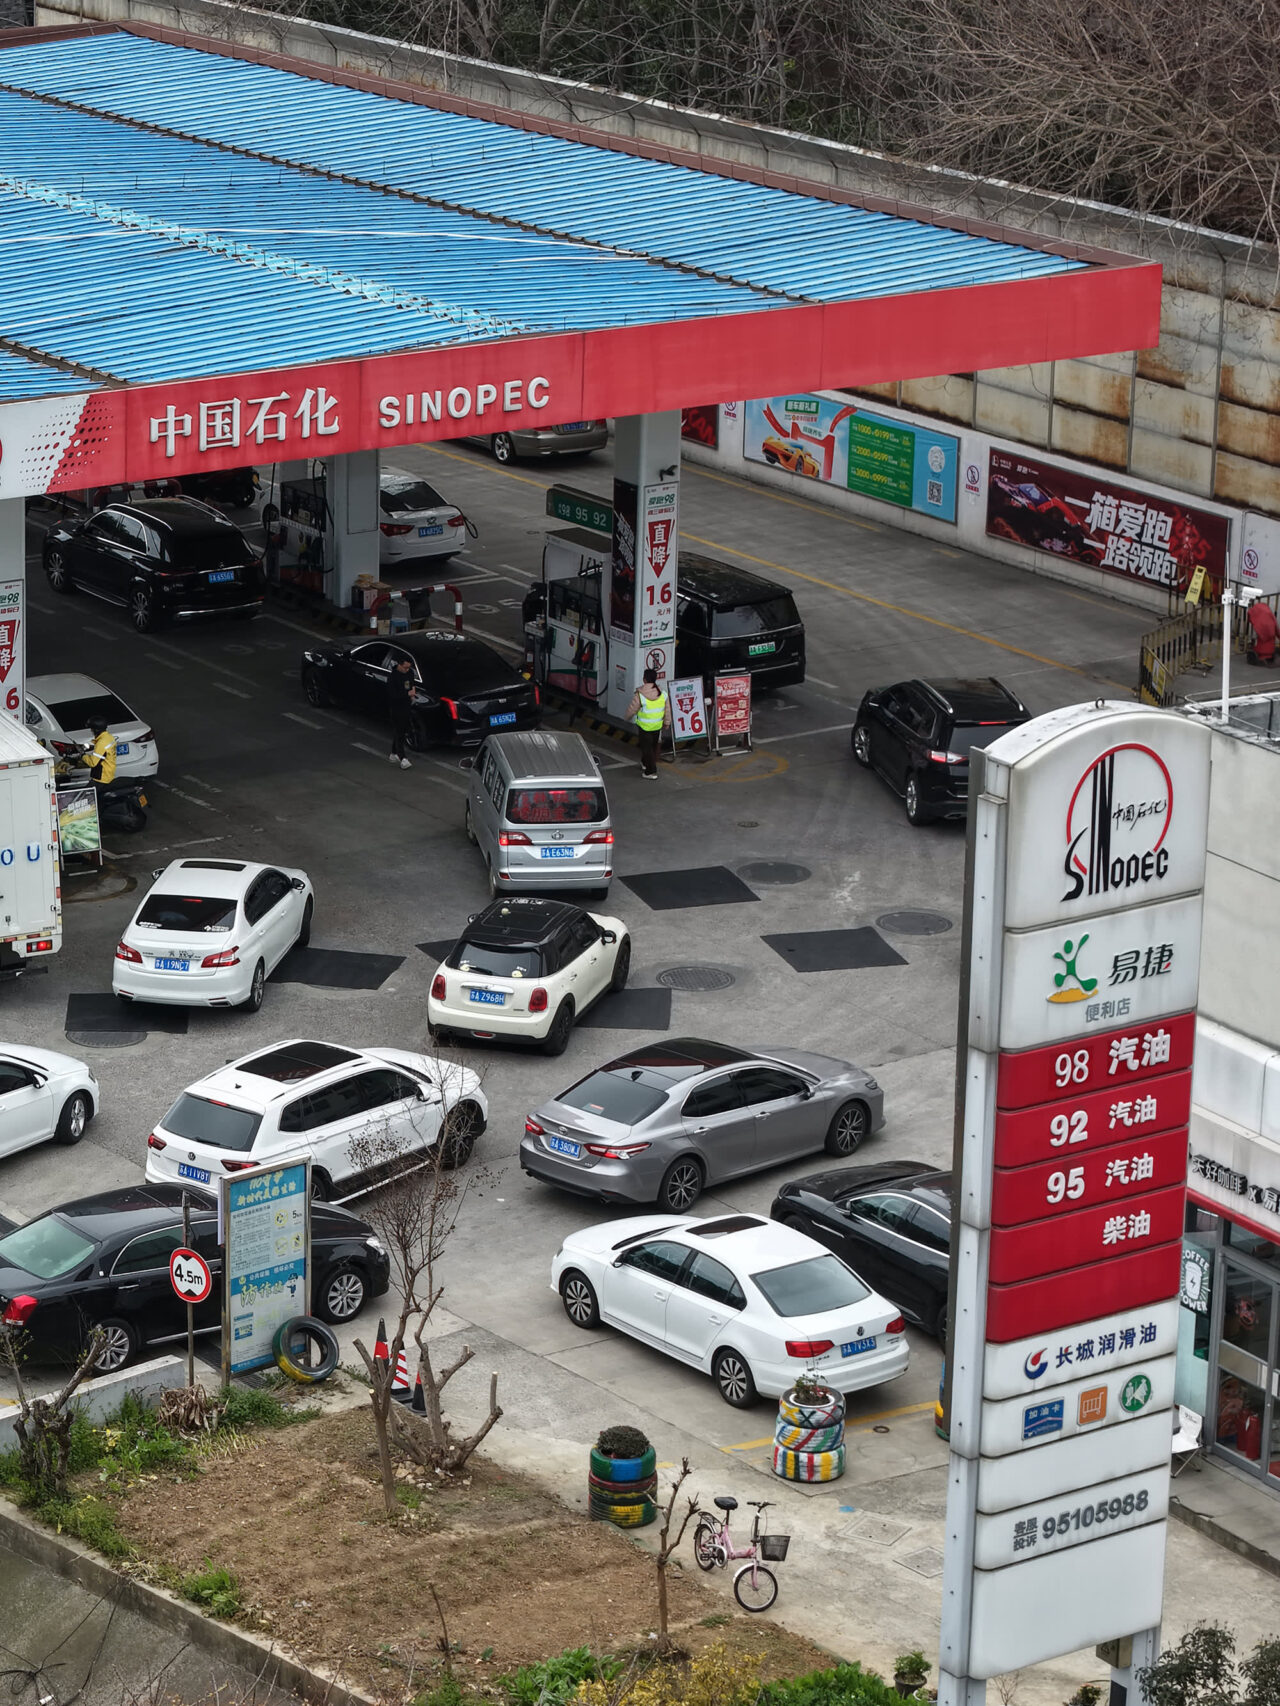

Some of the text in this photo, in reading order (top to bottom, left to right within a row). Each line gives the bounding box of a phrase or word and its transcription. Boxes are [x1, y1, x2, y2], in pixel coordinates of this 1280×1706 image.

[378, 376, 551, 428] SINOPEC
[149, 387, 341, 458] 中国石化
[575, 507, 588, 521] 95
[593, 512, 607, 527] 92
[1064, 491, 1173, 550] 一箱爱跑
[653, 524, 666, 566] 直降
[646, 582, 671, 606] 1.6
[678, 712, 703, 733] 1.6
[1108, 943, 1174, 985] 易捷
[1085, 998, 1131, 1023] 便利店
[1055, 1029, 1171, 1088] 98 汽油
[1050, 1095, 1157, 1147] 92 汽油
[1046, 1152, 1154, 1204] 95 汽油
[1264, 1188, 1280, 1216] 易
[1102, 1210, 1150, 1246] 柴油
[174, 1264, 204, 1286] 4.5m
[1055, 1322, 1157, 1369] 长城润滑油
[1029, 1403, 1061, 1419] 加油卡
[1014, 1517, 1038, 1535] 客服
[1042, 1489, 1148, 1539] 95105988
[1013, 1533, 1038, 1551] 投诉
